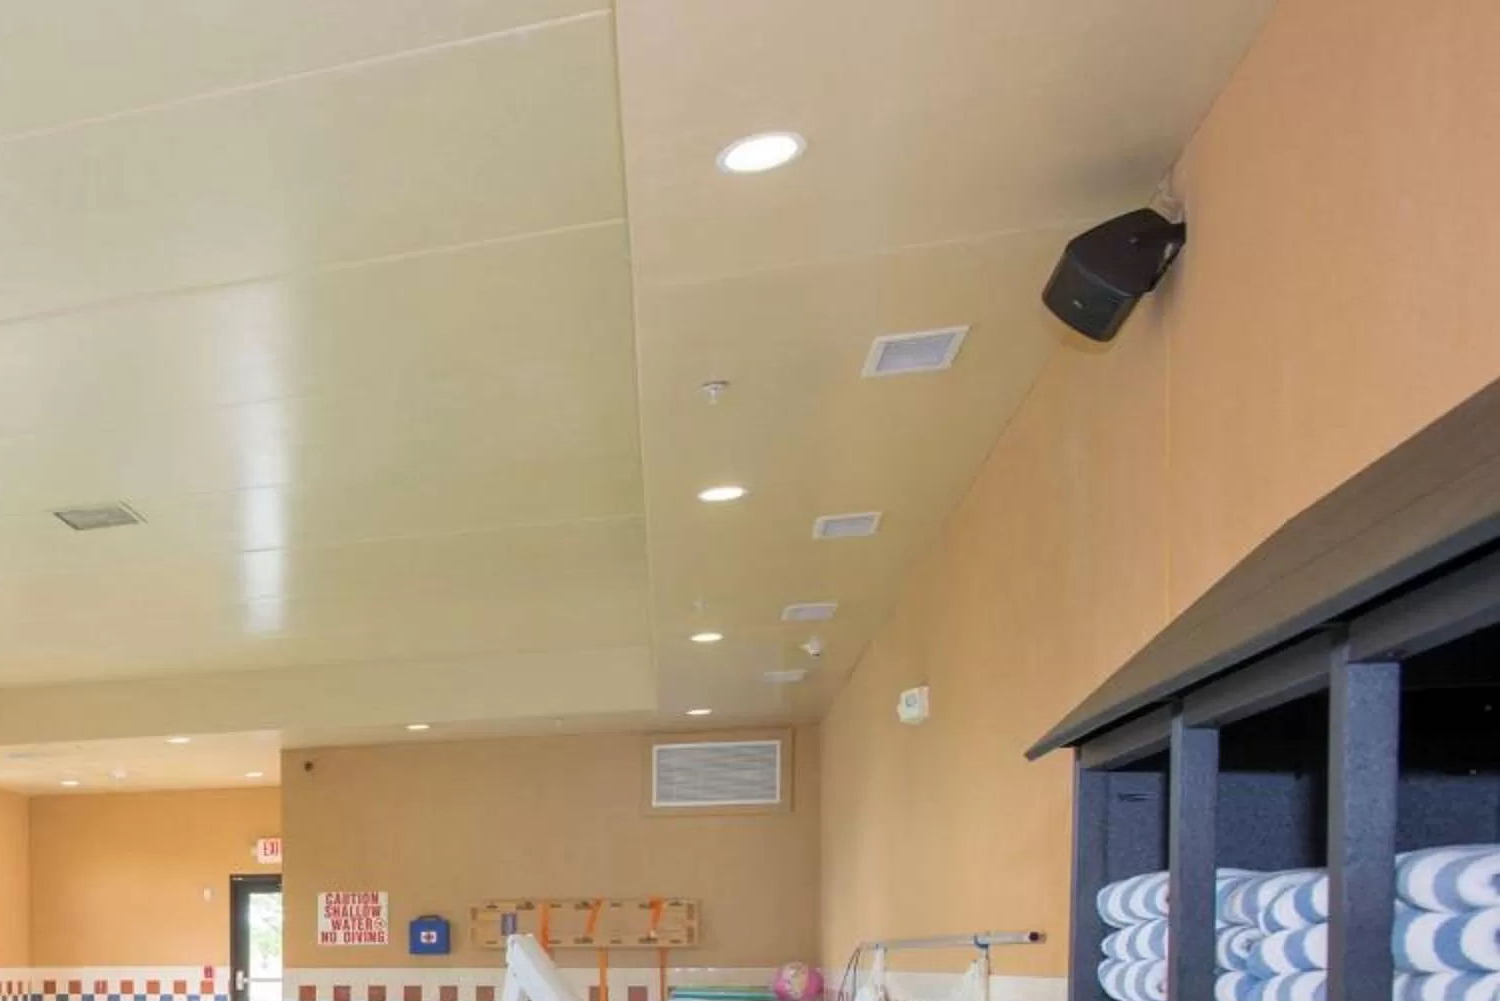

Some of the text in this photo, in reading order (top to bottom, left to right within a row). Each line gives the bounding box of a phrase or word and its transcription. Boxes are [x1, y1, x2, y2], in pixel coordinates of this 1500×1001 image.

[263, 841, 280, 856] EXI
[325, 892, 379, 905] CAUTION
[324, 905, 382, 918] SHALLOW
[331, 918, 373, 930] WATER
[321, 931, 385, 943] NO DIVING
